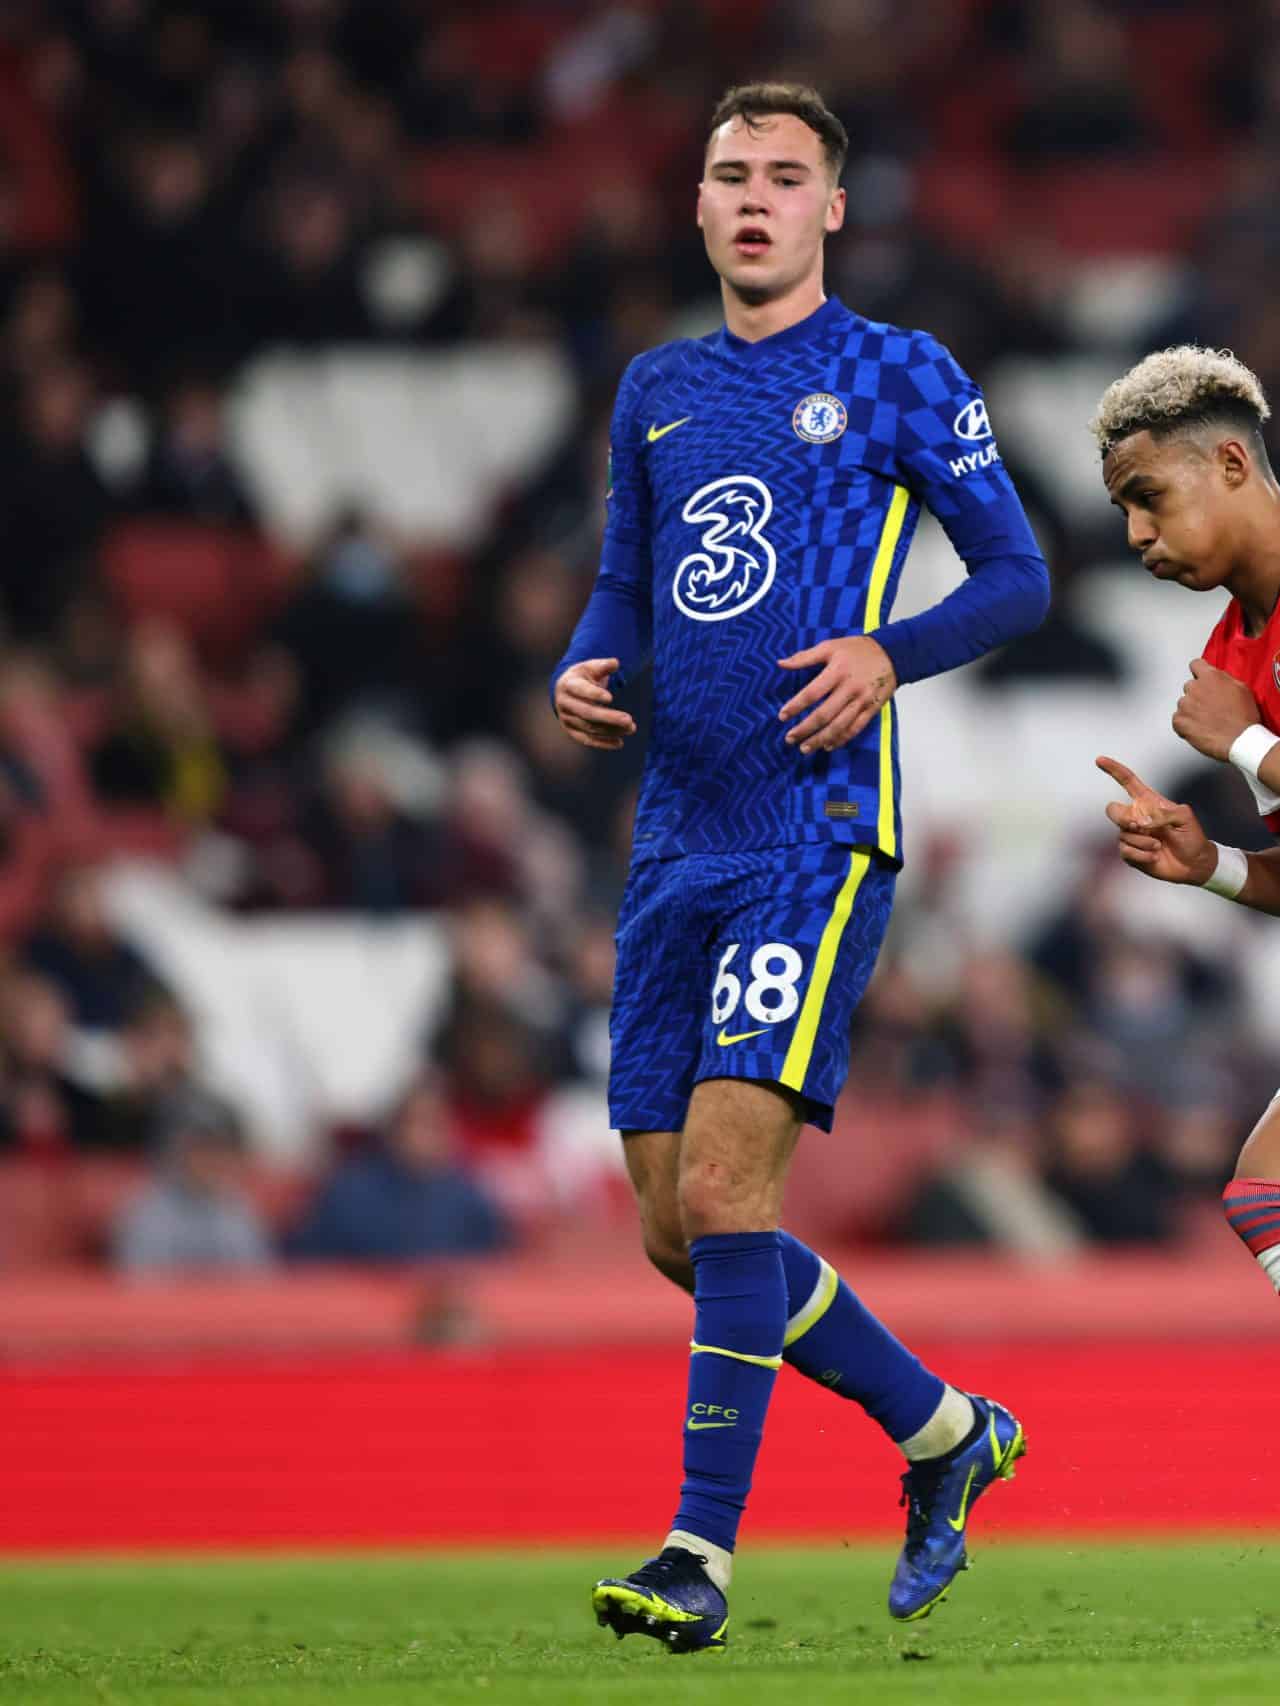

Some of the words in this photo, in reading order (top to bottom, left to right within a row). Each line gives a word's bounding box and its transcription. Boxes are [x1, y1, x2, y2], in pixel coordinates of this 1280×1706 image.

[672, 474, 777, 622] 3
[711, 942, 803, 1024] 68
[691, 1402, 740, 1420] CFC
